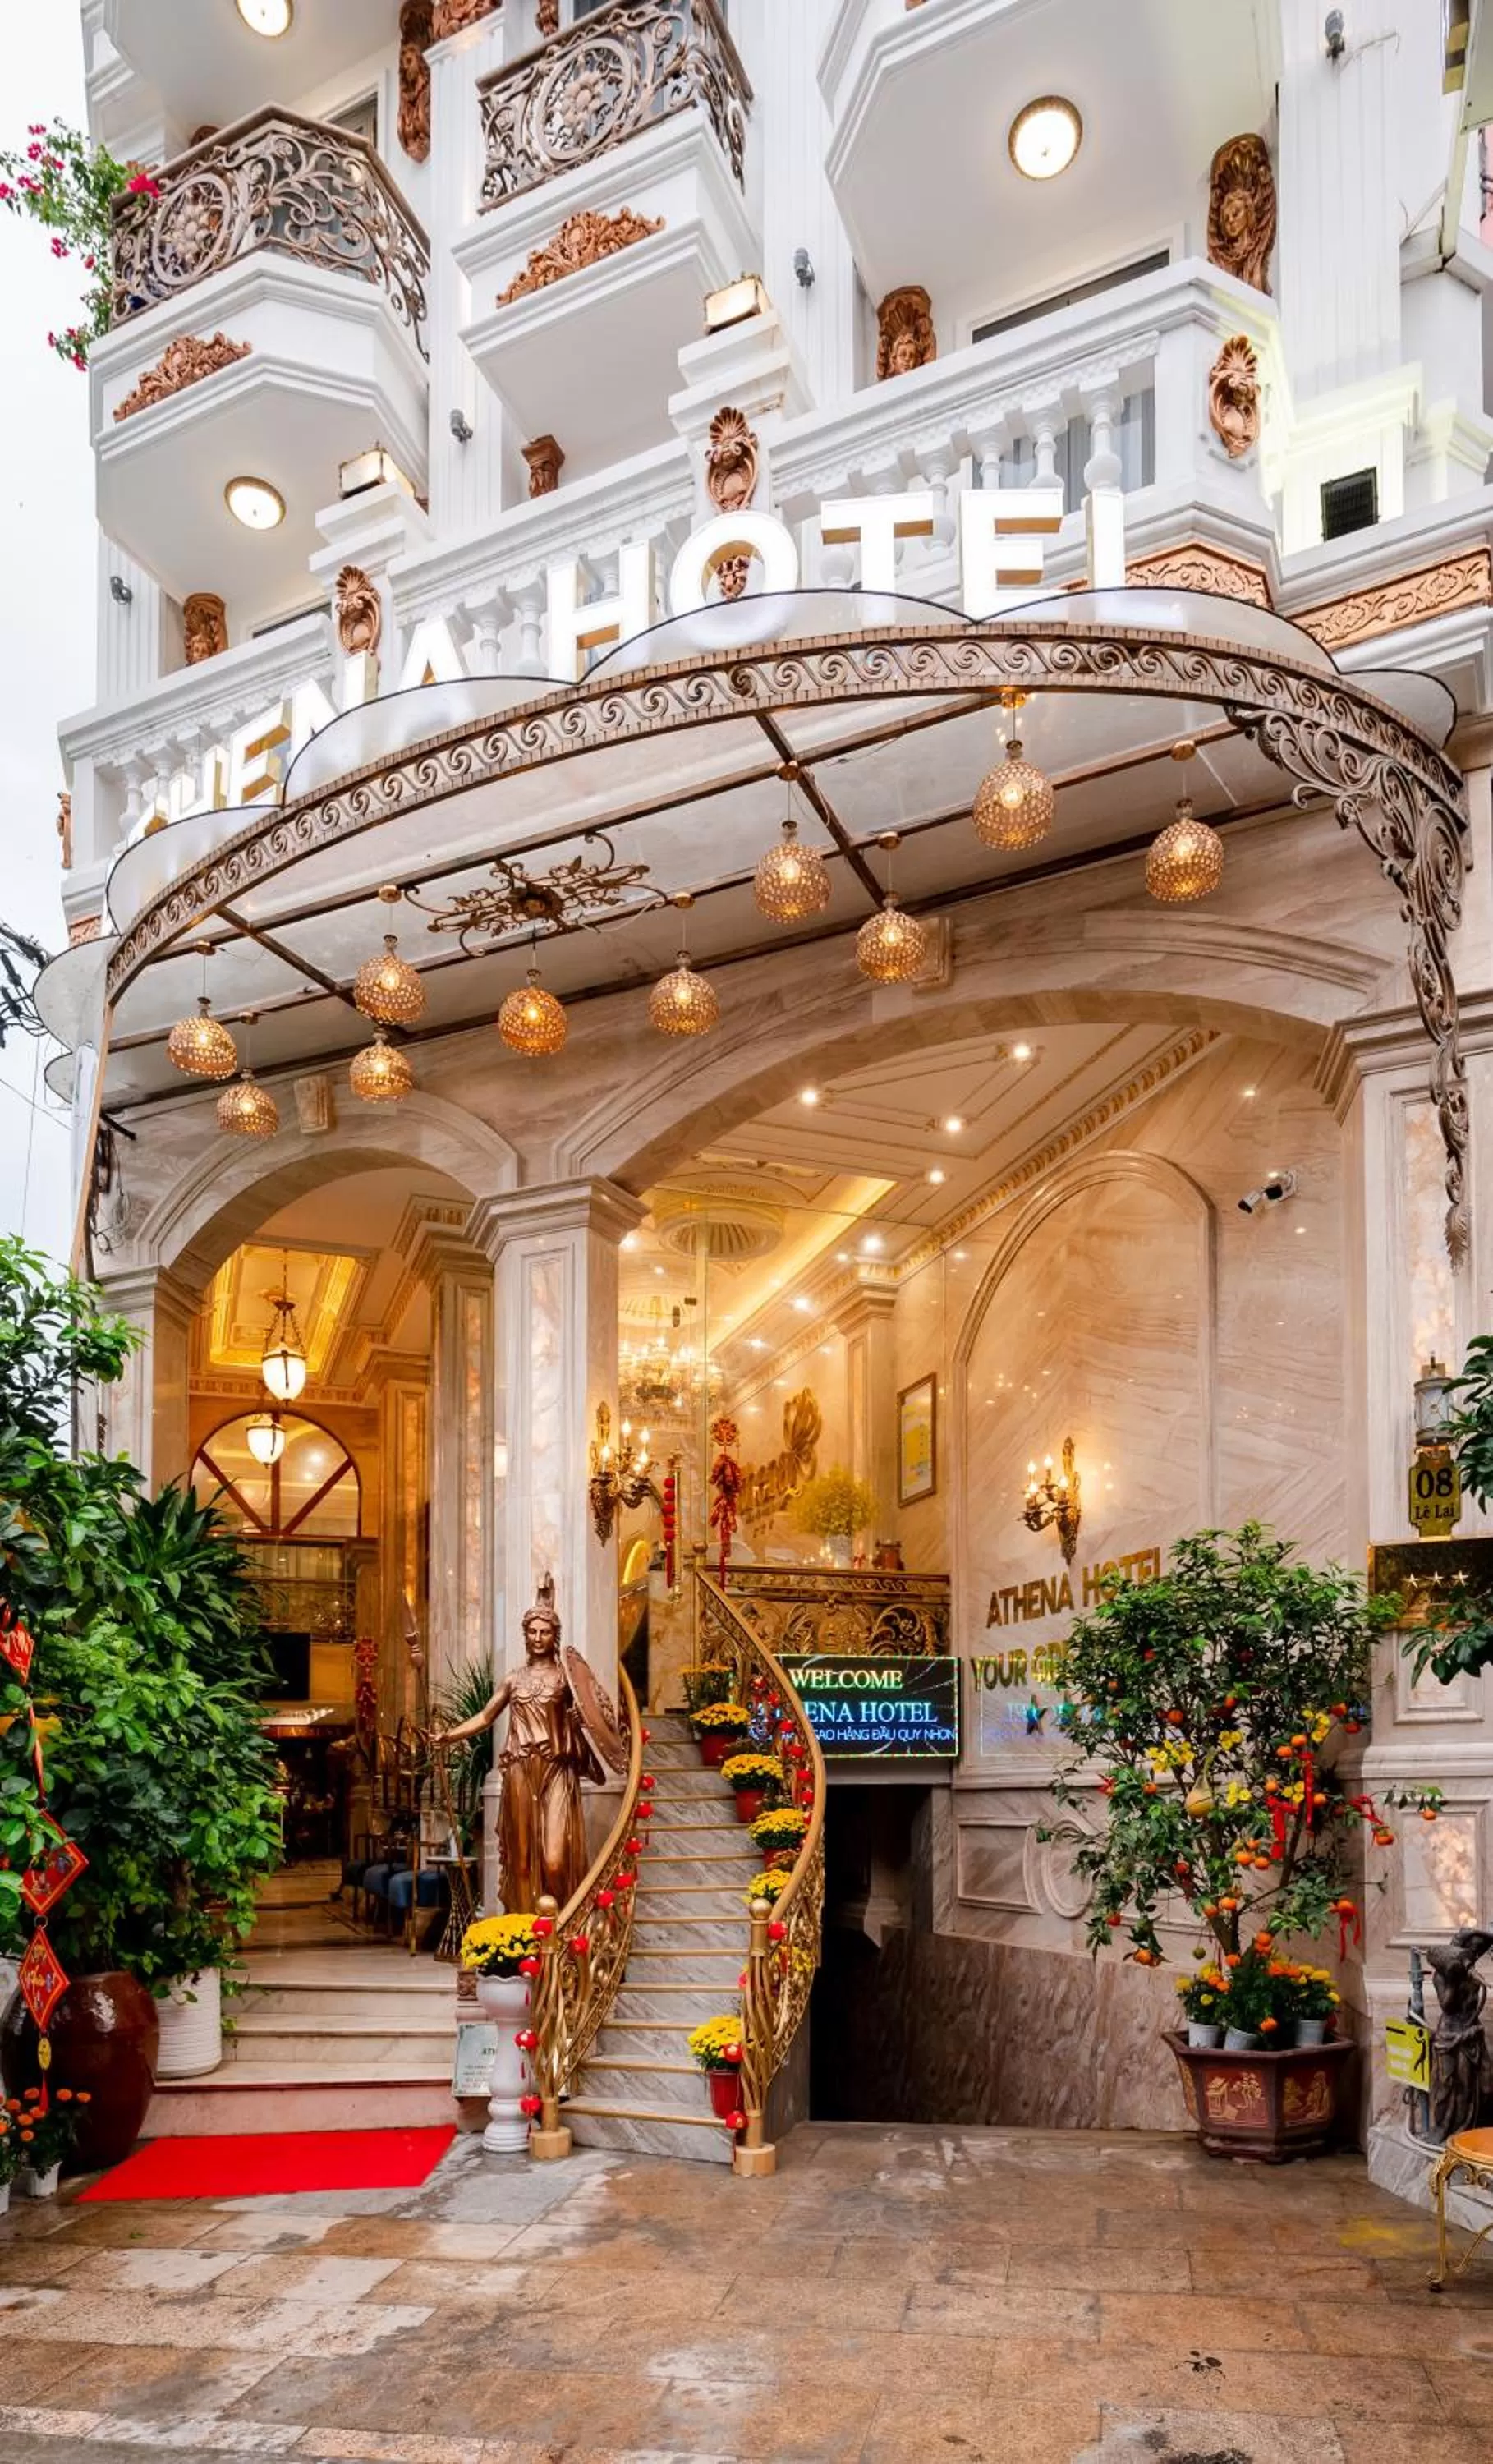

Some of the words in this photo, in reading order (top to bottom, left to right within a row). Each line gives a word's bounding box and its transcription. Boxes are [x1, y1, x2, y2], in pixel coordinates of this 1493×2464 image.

[1416, 1467, 1454, 1498] 08
[1415, 1504, 1431, 1519] Lê
[1435, 1502, 1454, 1519] Lai
[986, 1572, 1075, 1629] ATHENA
[788, 1668, 903, 1689] WELCOME
[971, 1648, 1027, 1693] YOUR
[861, 1701, 938, 1722] HOTEL
[898, 1729, 922, 1742] QUY
